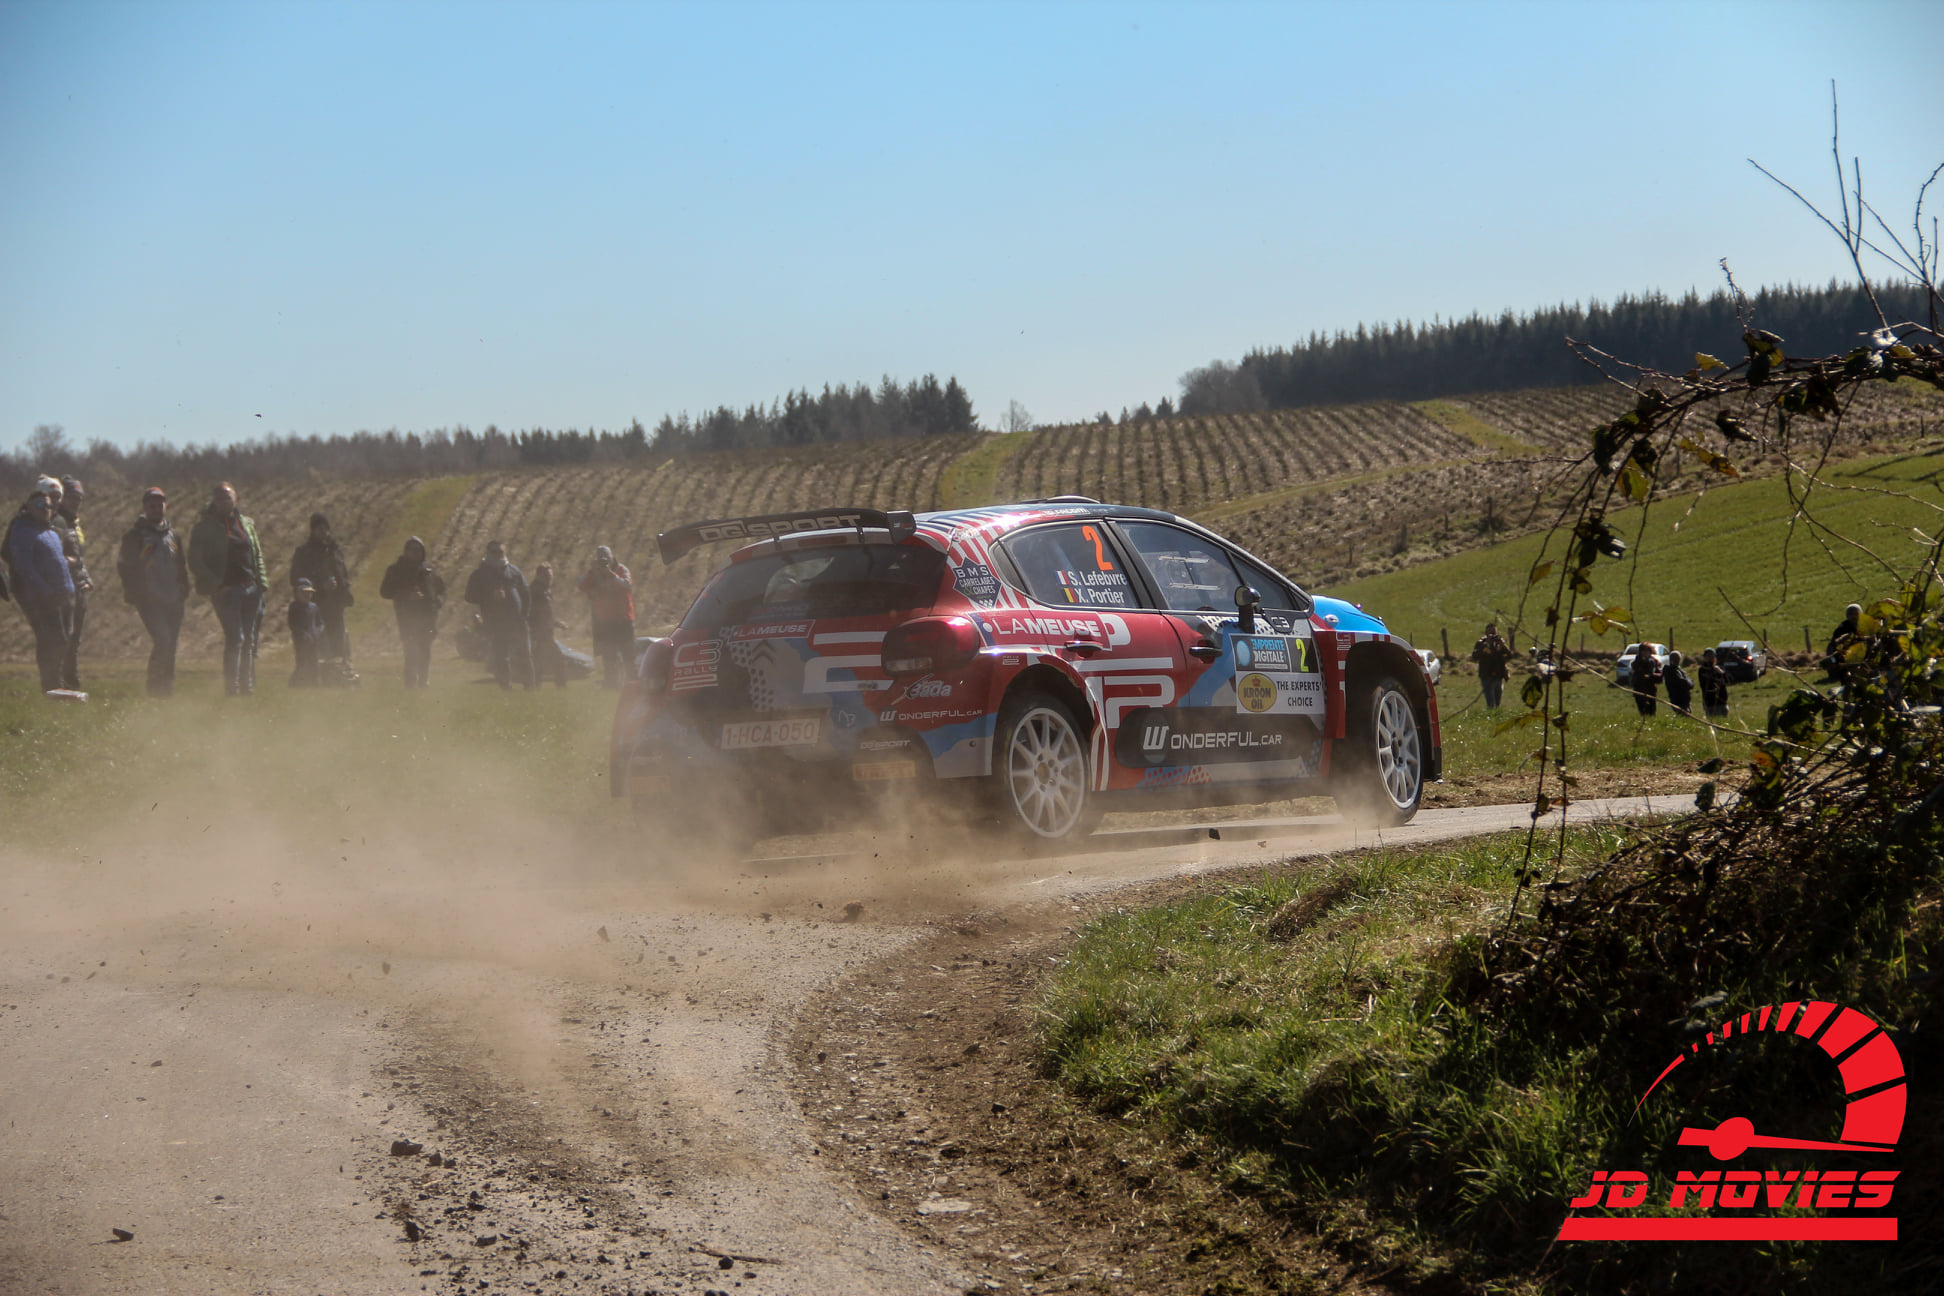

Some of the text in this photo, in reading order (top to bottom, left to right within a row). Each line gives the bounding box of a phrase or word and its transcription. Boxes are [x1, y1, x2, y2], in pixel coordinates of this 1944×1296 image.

[700, 514, 861, 542] DG SPORT
[1081, 525, 1114, 571] 2
[1068, 571, 1127, 586] S. Lefebvre
[1075, 588, 1125, 603] X. Portier
[674, 639, 724, 667] C3
[1253, 650, 1285, 663] DIGITALE
[1296, 638, 1310, 673] 2
[1276, 680, 1290, 691] THE
[1287, 697, 1313, 707] CHOICE
